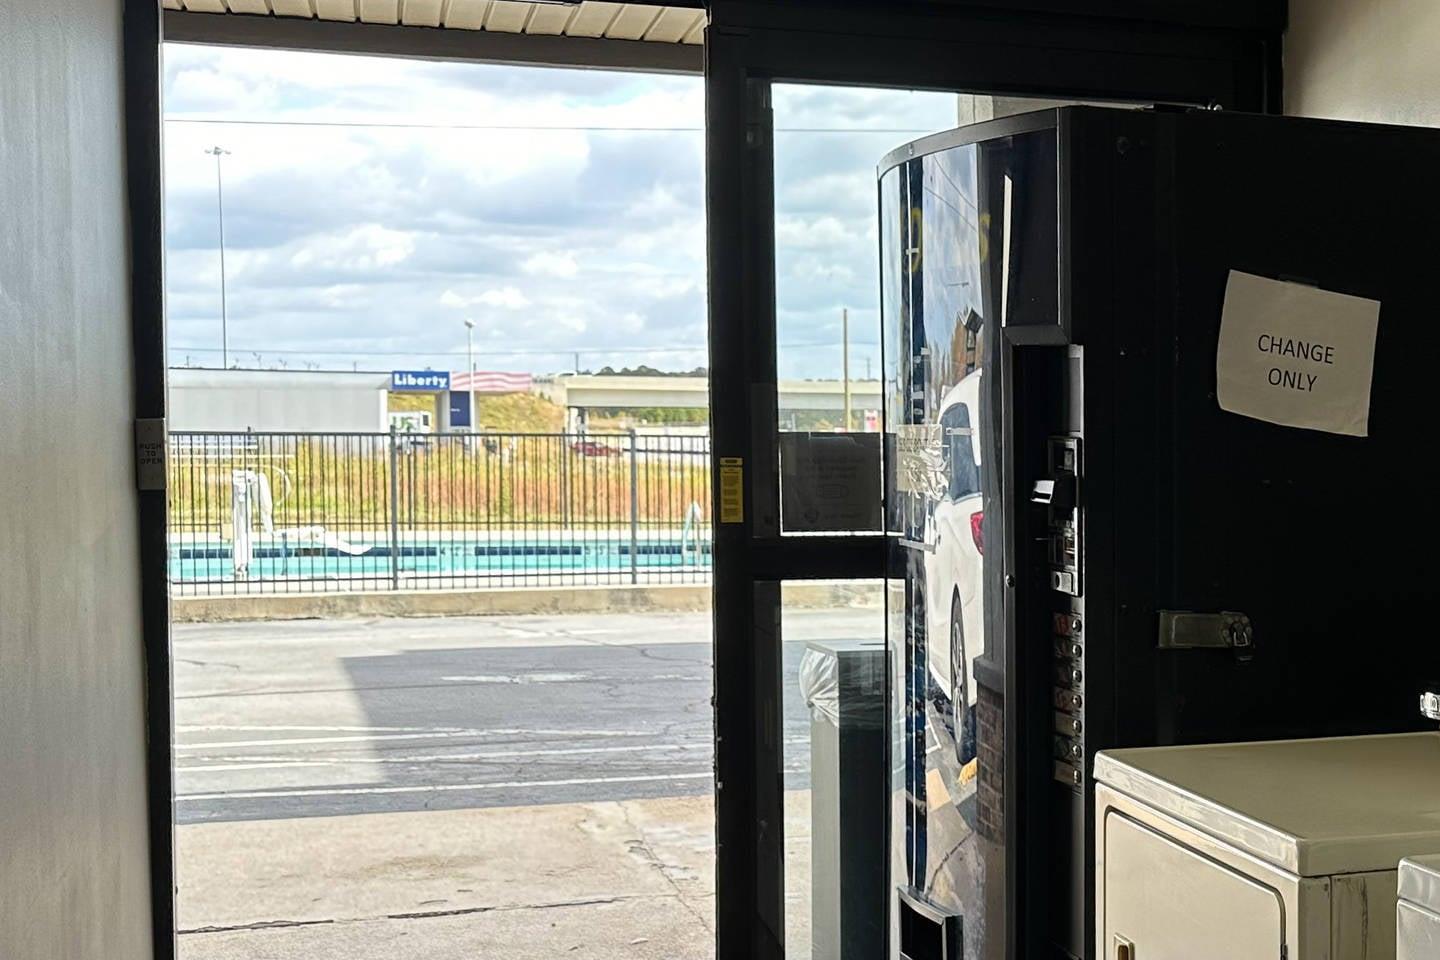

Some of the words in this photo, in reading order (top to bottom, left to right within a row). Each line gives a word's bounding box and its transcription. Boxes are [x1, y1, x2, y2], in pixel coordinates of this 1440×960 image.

[1257, 334, 1335, 364] CHANGE
[393, 373, 448, 388] Liberty
[1268, 368, 1318, 392] ONLY
